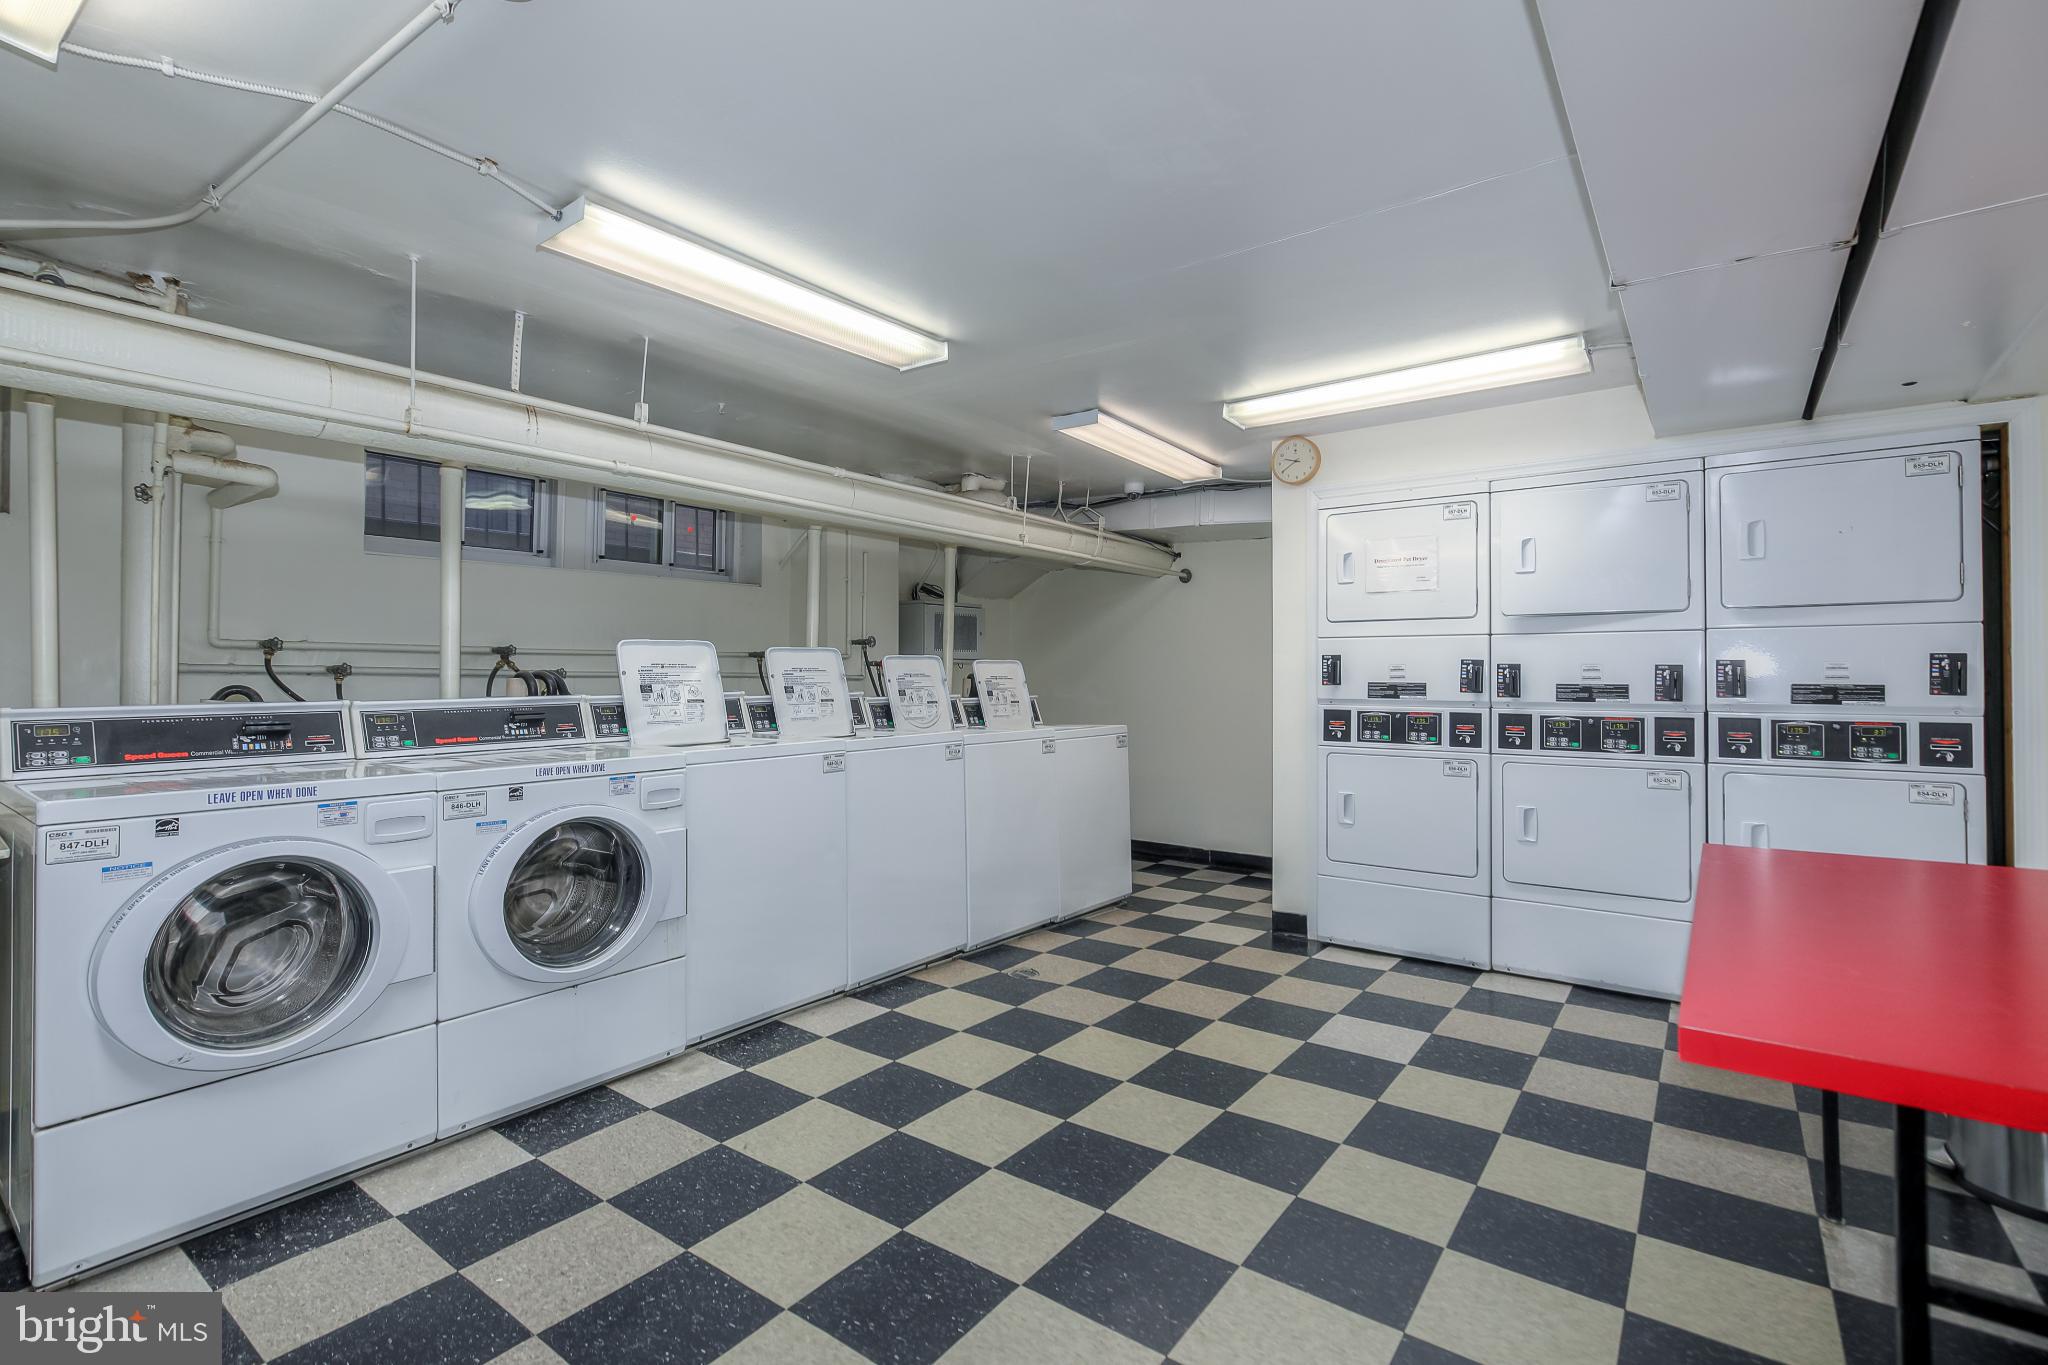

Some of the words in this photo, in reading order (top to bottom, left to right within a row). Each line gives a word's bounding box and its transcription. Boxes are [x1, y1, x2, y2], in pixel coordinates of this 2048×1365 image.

[124, 752, 157, 761] Speed
[157, 751, 189, 759] Queen
[535, 767, 554, 777] LEAVE
[555, 766, 571, 776] OPEN
[572, 764, 590, 774] WHEN
[591, 763, 606, 772] DONE
[207, 792, 237, 805] LEAVE
[240, 790, 264, 802] OPEN
[267, 788, 293, 800] WHEN
[295, 786, 318, 798] DONE
[59, 838, 110, 851] 847-DLH
